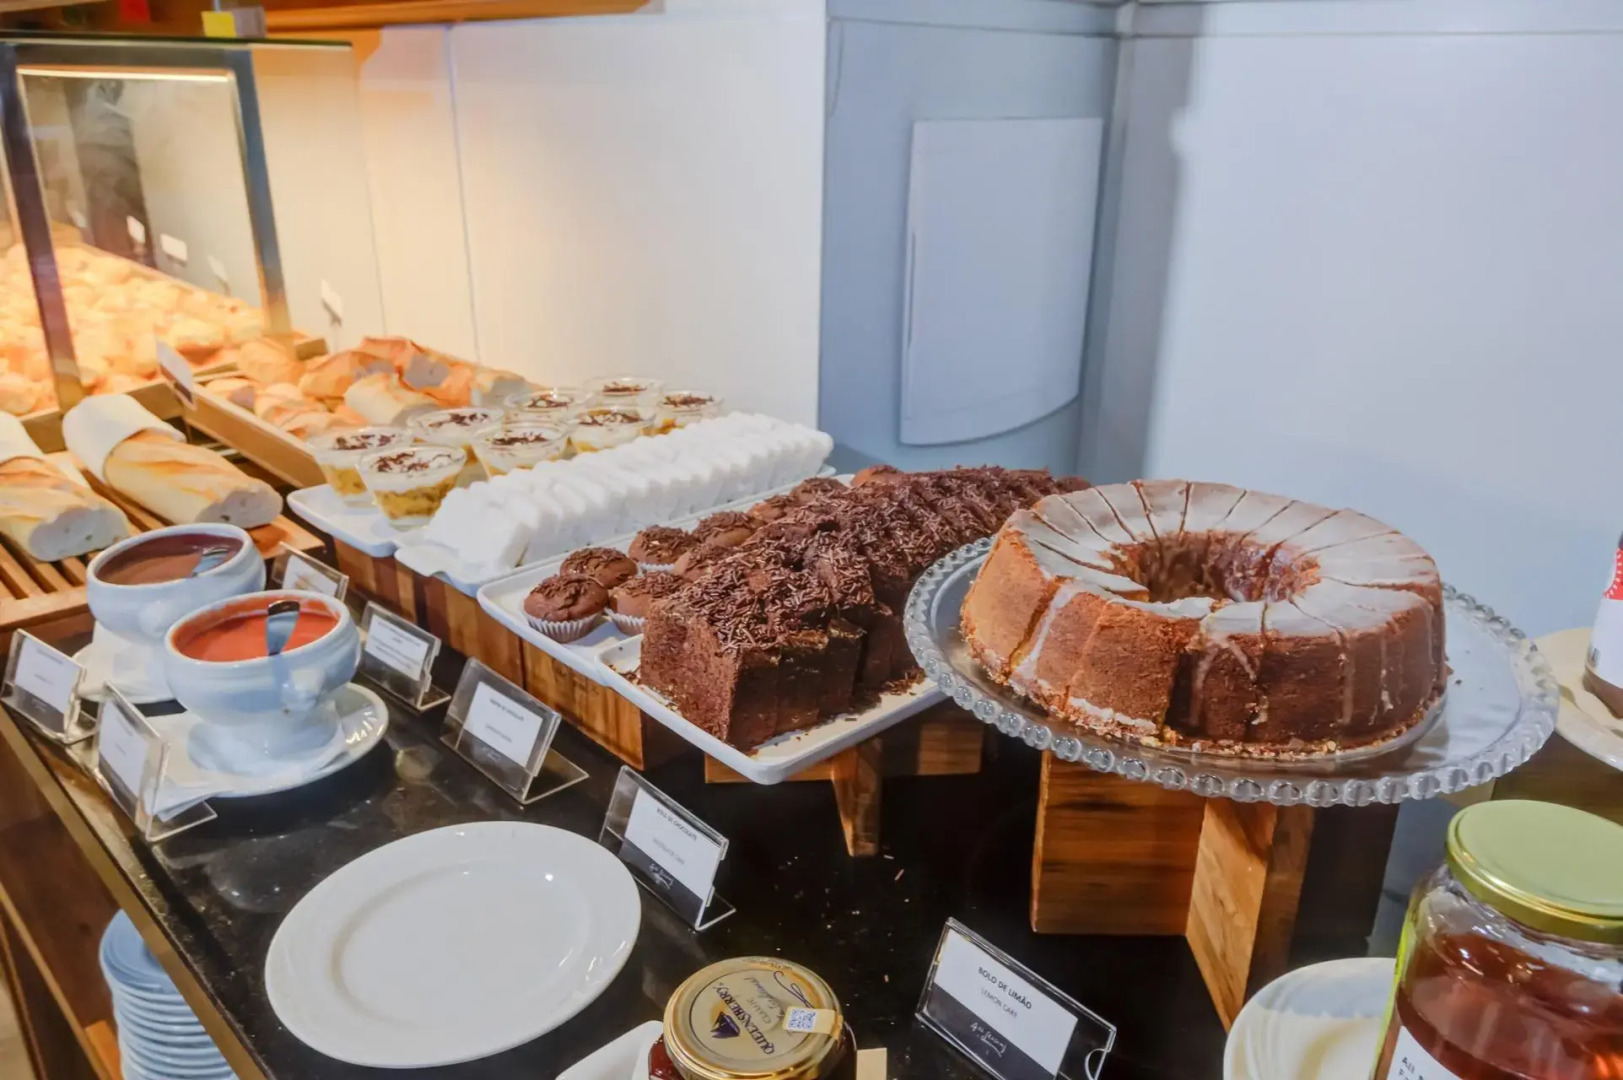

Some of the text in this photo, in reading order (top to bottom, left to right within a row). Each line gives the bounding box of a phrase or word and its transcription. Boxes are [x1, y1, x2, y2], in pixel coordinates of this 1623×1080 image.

[978, 966, 1032, 1010] BOLO DE LIMÃO
[981, 987, 1018, 1018] LEMON CAKE
[712, 985, 775, 1055] QUEENSBERRY
